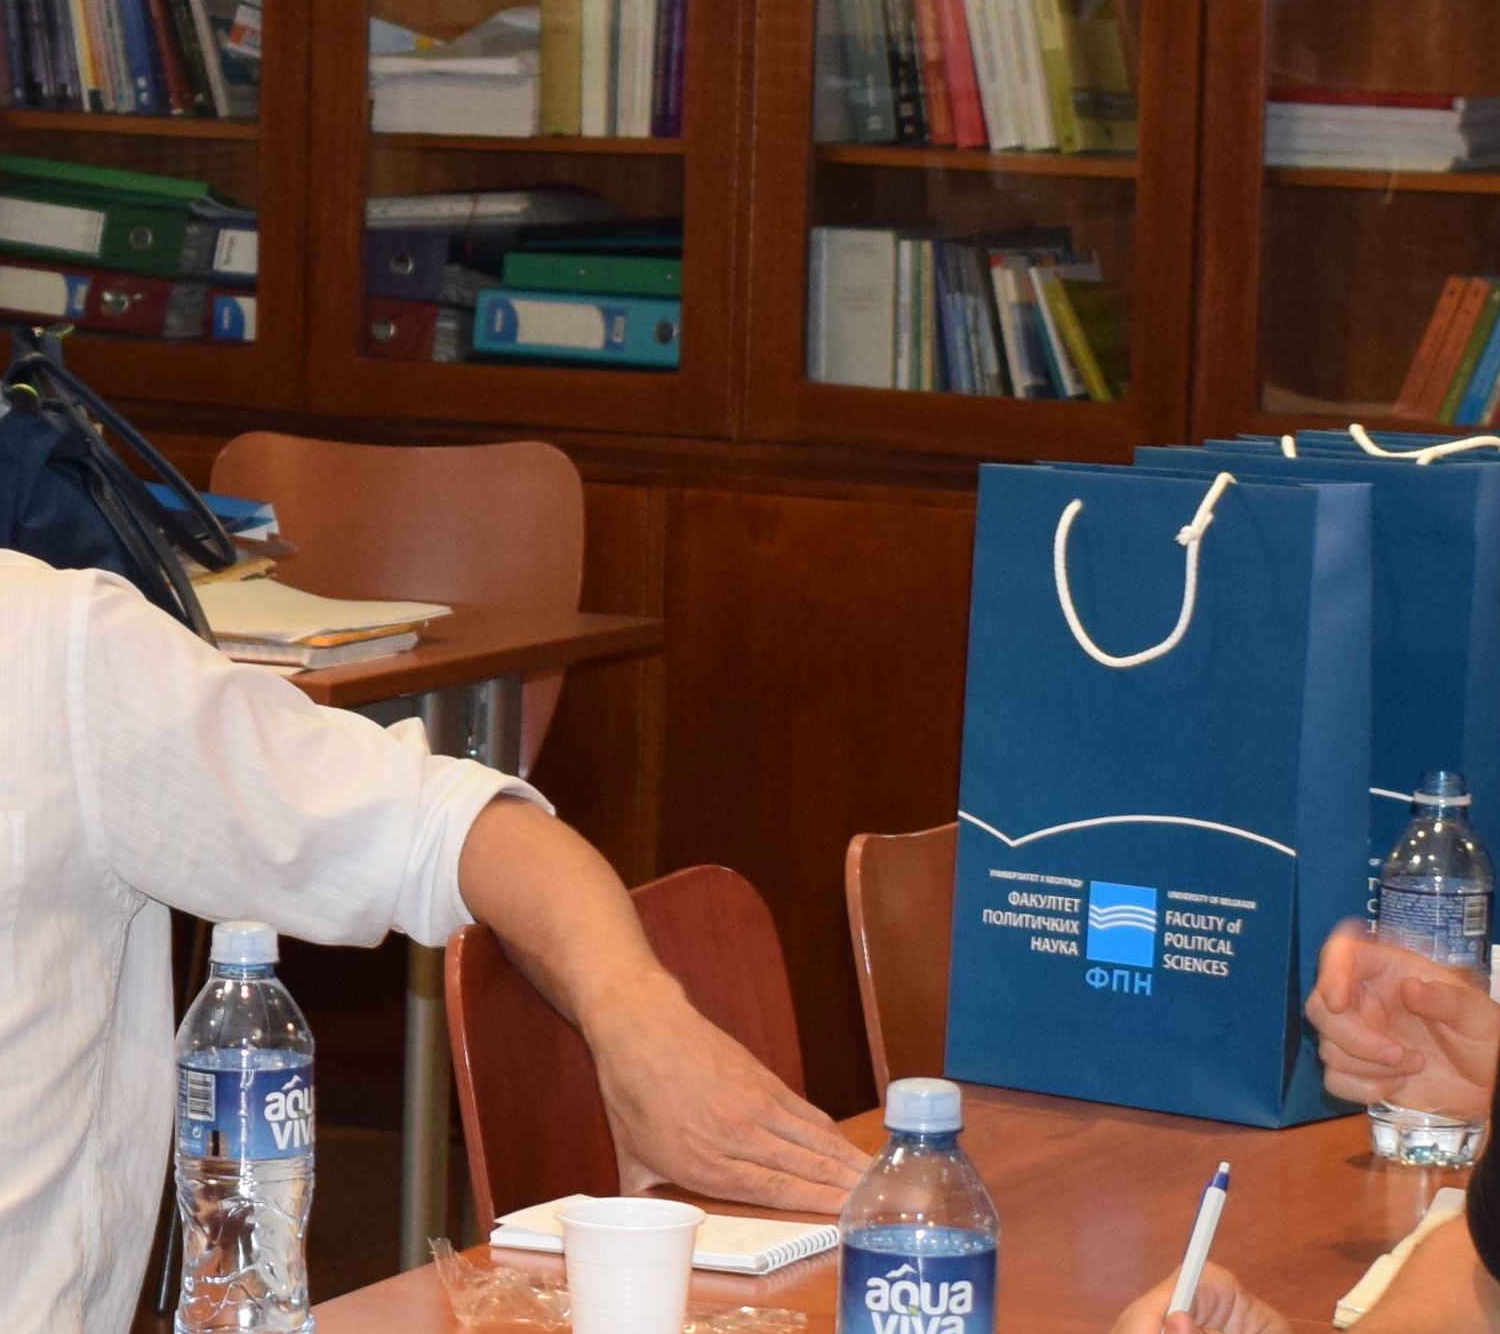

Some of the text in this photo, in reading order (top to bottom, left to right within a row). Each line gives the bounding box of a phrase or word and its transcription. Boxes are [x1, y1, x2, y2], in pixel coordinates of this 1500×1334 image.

[1008, 891, 1081, 913] ФАКУЛТЕТ
[982, 909, 1080, 935] ПОЛИТИЧКИХ
[1165, 910, 1243, 934] FACULTY of
[1031, 936, 1079, 957] НАУКА
[1164, 932, 1235, 956] POLITICAL
[1162, 953, 1229, 977] SCIENCES
[1085, 967, 1154, 997] ФПН
[270, 1117, 315, 1152] viv
[864, 1272, 974, 1316] aqua
